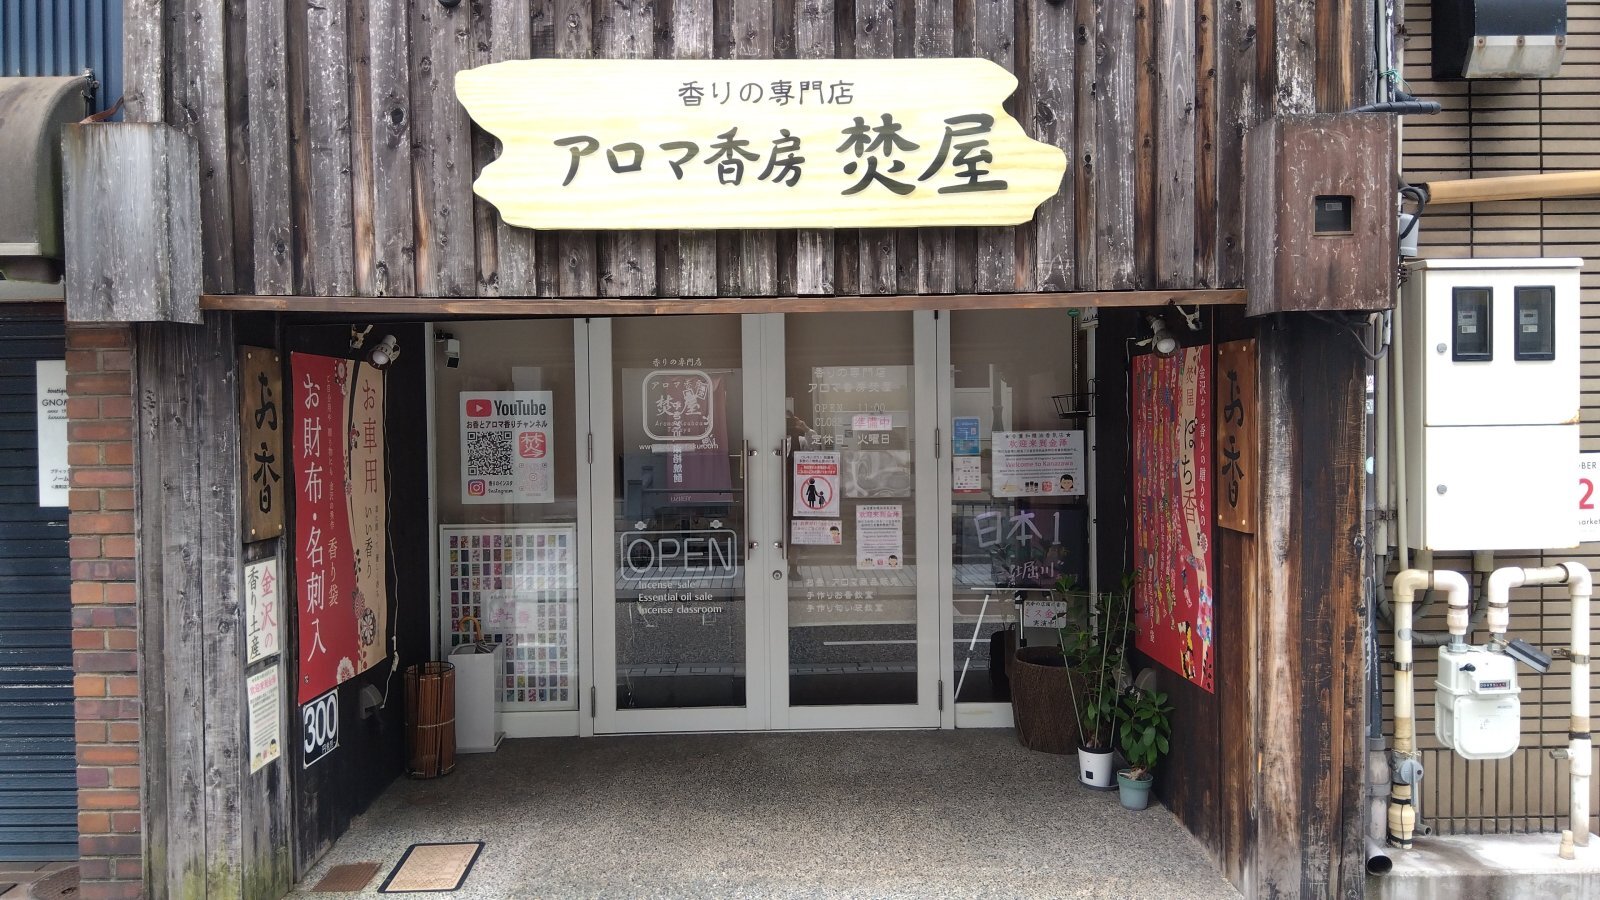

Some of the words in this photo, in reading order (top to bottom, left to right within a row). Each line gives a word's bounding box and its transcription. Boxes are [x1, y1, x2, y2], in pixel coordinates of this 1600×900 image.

[678, 80, 854, 106] 香りの専門店
[553, 127, 805, 187] アロマ香房
[835, 113, 1008, 196] 焚屋
[652, 358, 702, 367] 香りの専門店
[494, 400, 546, 416] YouTube
[466, 420, 548, 429] お香とアロマ香りチャンネル
[855, 416, 890, 428] 準備中
[254, 372, 281, 514] お香
[362, 379, 377, 494] お車用
[811, 434, 844, 444] 定休日
[858, 434, 890, 444] 火曜日
[1199, 367, 1207, 527] 金沢から香りの贈りもの
[1221, 369, 1244, 508] お香
[1006, 460, 1033, 468] Welcome
[1042, 459, 1074, 467] Kanazawa
[1579, 461, 1597, 470] BER
[303, 373, 326, 662] お財布・名刺入
[1579, 518, 1600, 526] arket
[627, 537, 732, 573] OPEN
[327, 537, 339, 607] 香り袋
[639, 581, 673, 589] Incense
[677, 580, 697, 588] sale
[261, 566, 276, 648] 金沢の
[638, 593, 678, 602] Essential
[680, 593, 692, 601] oil
[694, 592, 713, 601] sale
[639, 606, 674, 614] Incense
[676, 604, 722, 614] classroom
[247, 566, 261, 660] 香り土産
[304, 694, 337, 753] 300
